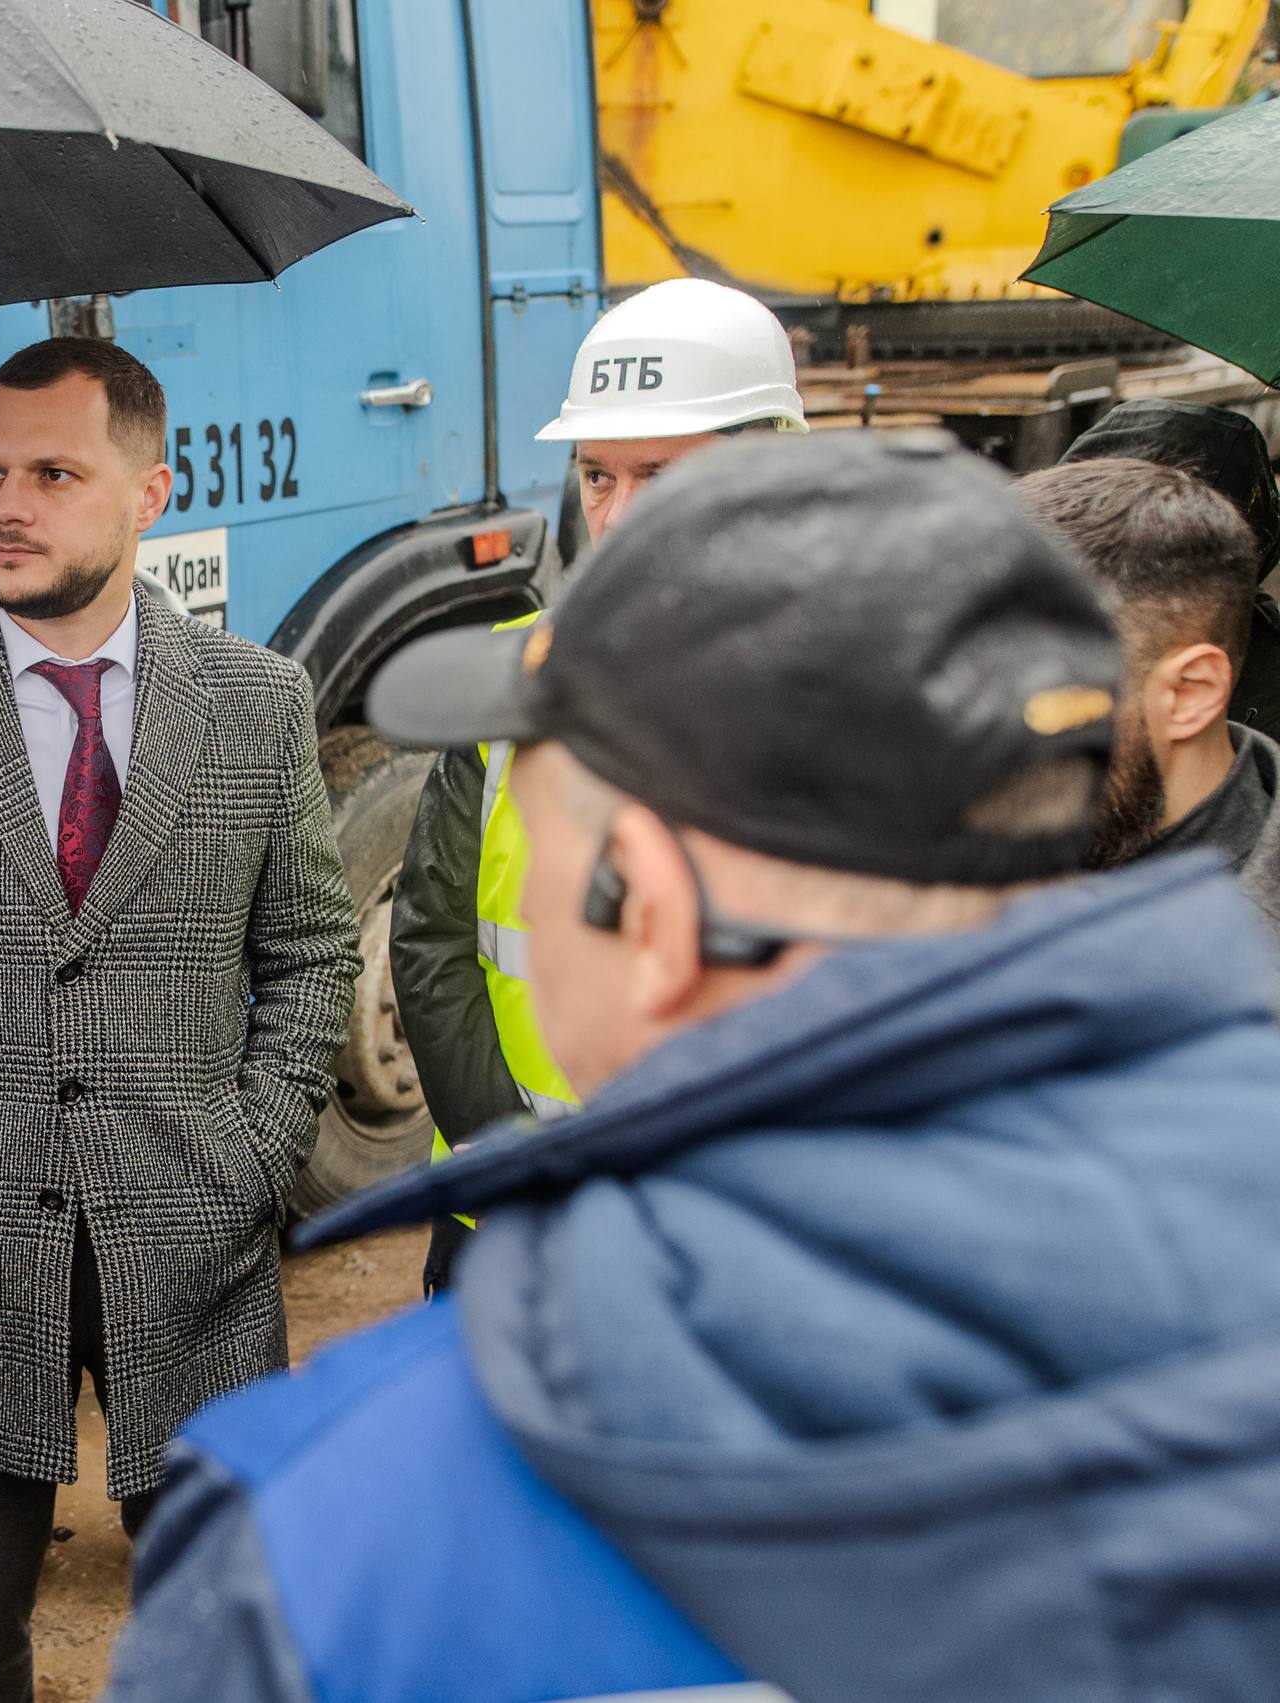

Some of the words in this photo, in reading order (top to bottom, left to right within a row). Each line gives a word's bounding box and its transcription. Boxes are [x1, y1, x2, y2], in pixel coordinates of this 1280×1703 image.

[590, 356, 663, 394] БТБ
[205, 422, 244, 509] 31
[257, 416, 299, 502] 32
[168, 553, 220, 600] Кран
